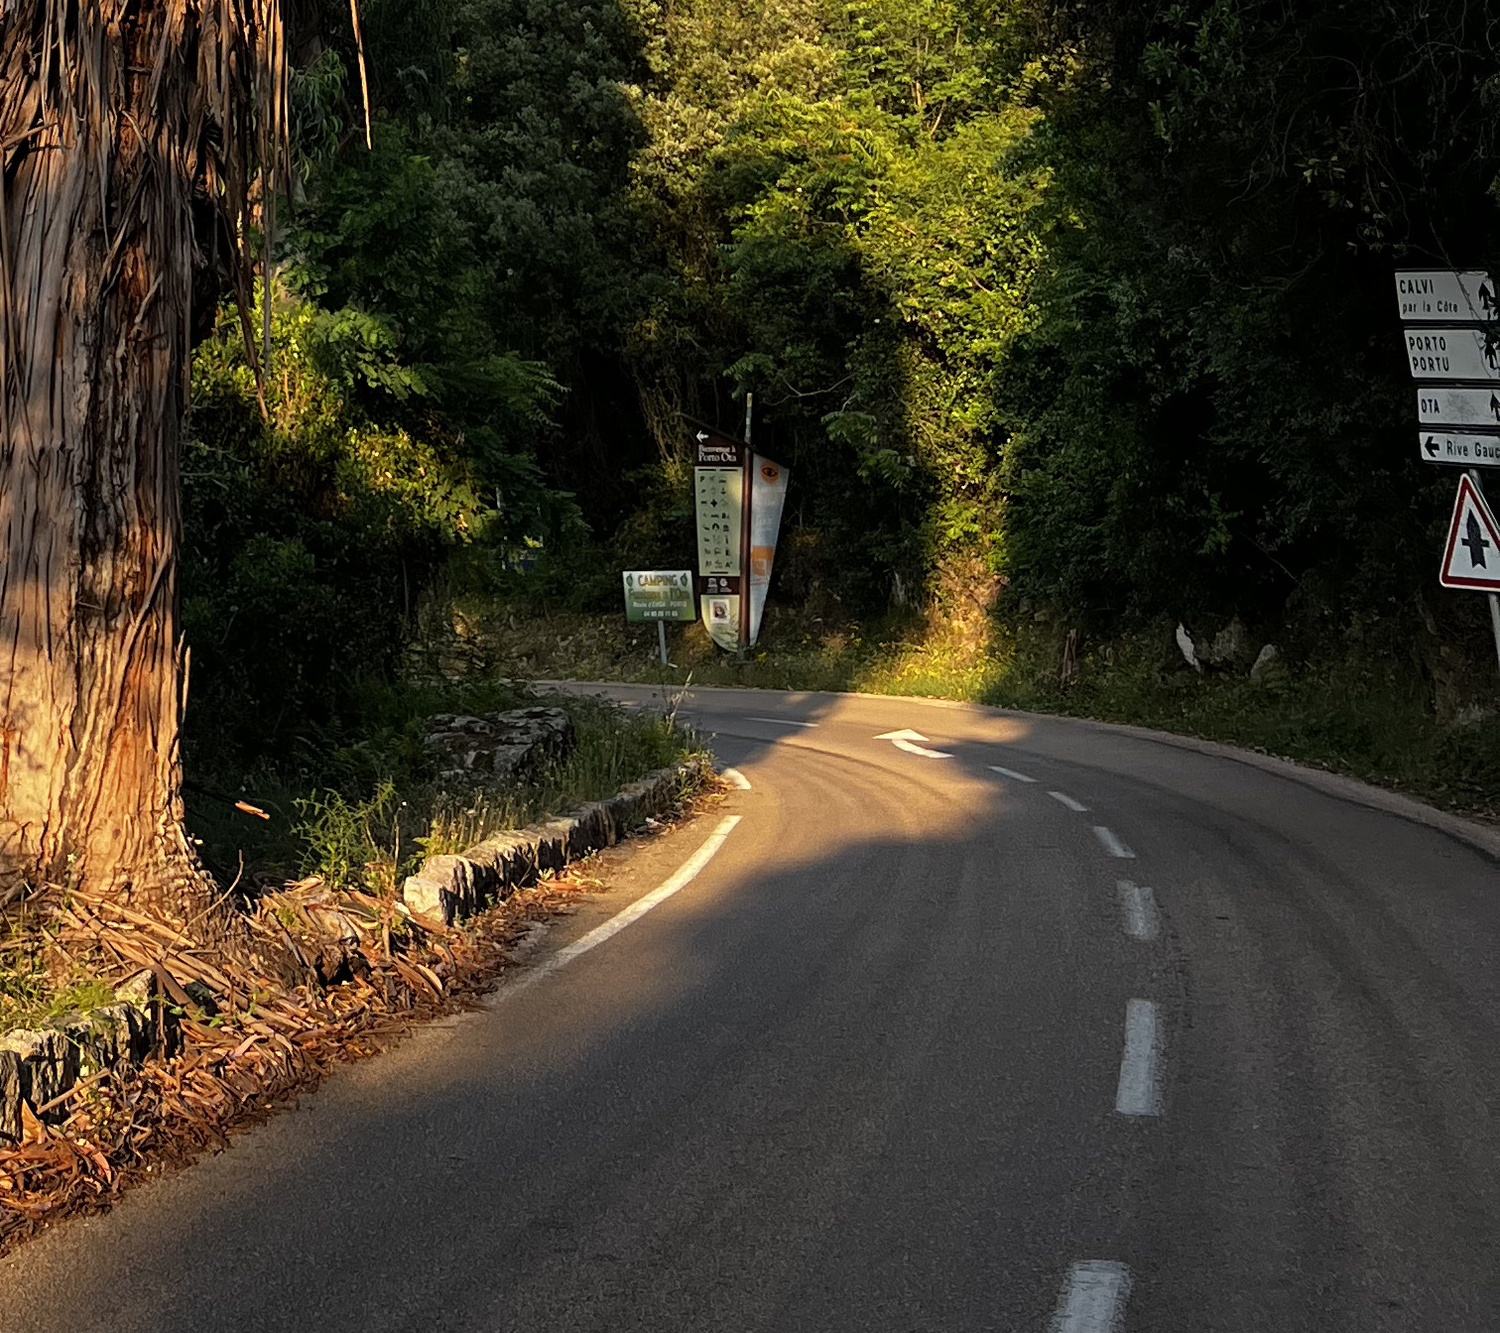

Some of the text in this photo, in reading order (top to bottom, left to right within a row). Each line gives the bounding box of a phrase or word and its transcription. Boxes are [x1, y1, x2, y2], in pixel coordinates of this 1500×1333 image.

[1400, 279, 1434, 294] CALVI
[1402, 300, 1458, 314] par la Côte
[1408, 336, 1446, 351] PORTO
[1412, 356, 1449, 371] PORTU
[1421, 399, 1440, 413] OTA
[1446, 440, 1468, 457] Rive
[698, 452, 737, 462] Porto Ota
[638, 574, 678, 587] CAMPING
